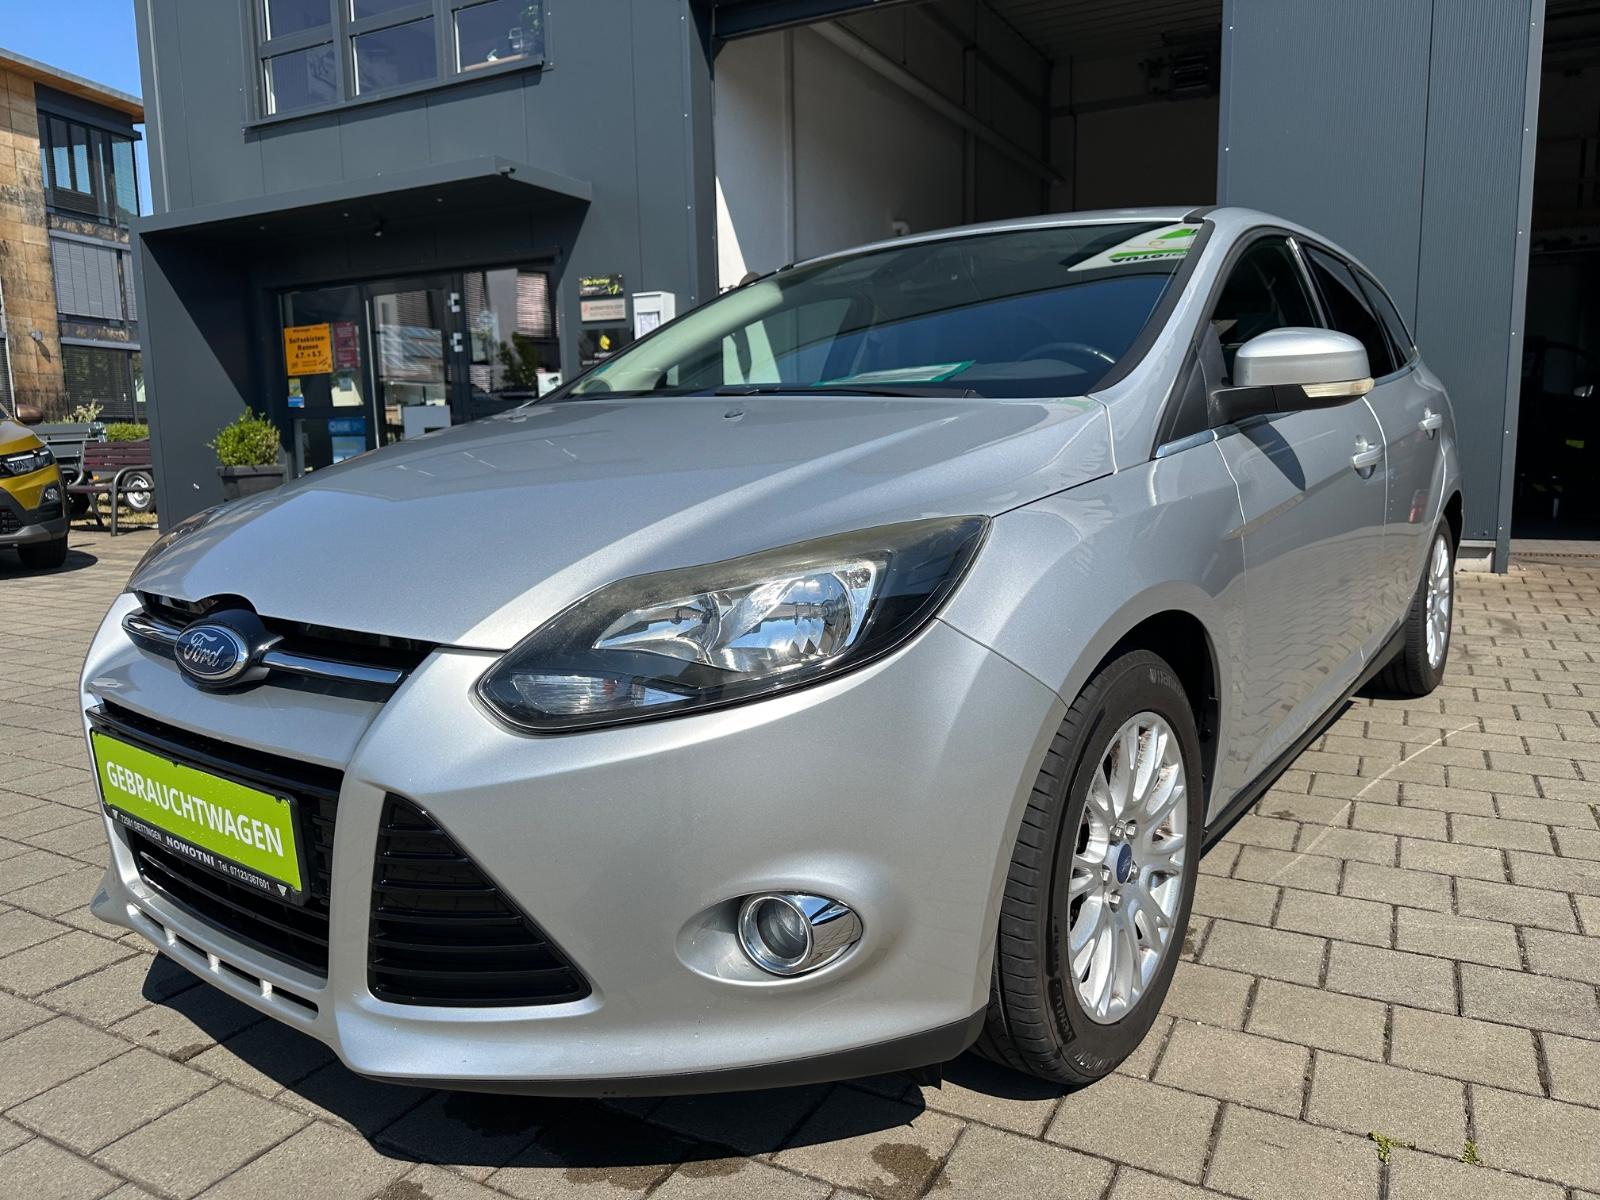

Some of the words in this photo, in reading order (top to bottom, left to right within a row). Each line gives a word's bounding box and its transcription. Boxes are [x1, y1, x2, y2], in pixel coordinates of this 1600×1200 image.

[183, 632, 225, 667] Ford
[105, 761, 285, 858] GEBRAUCHTWAGEN
[166, 835, 215, 867] NOWOTNI
[217, 860, 229, 873] Tel.
